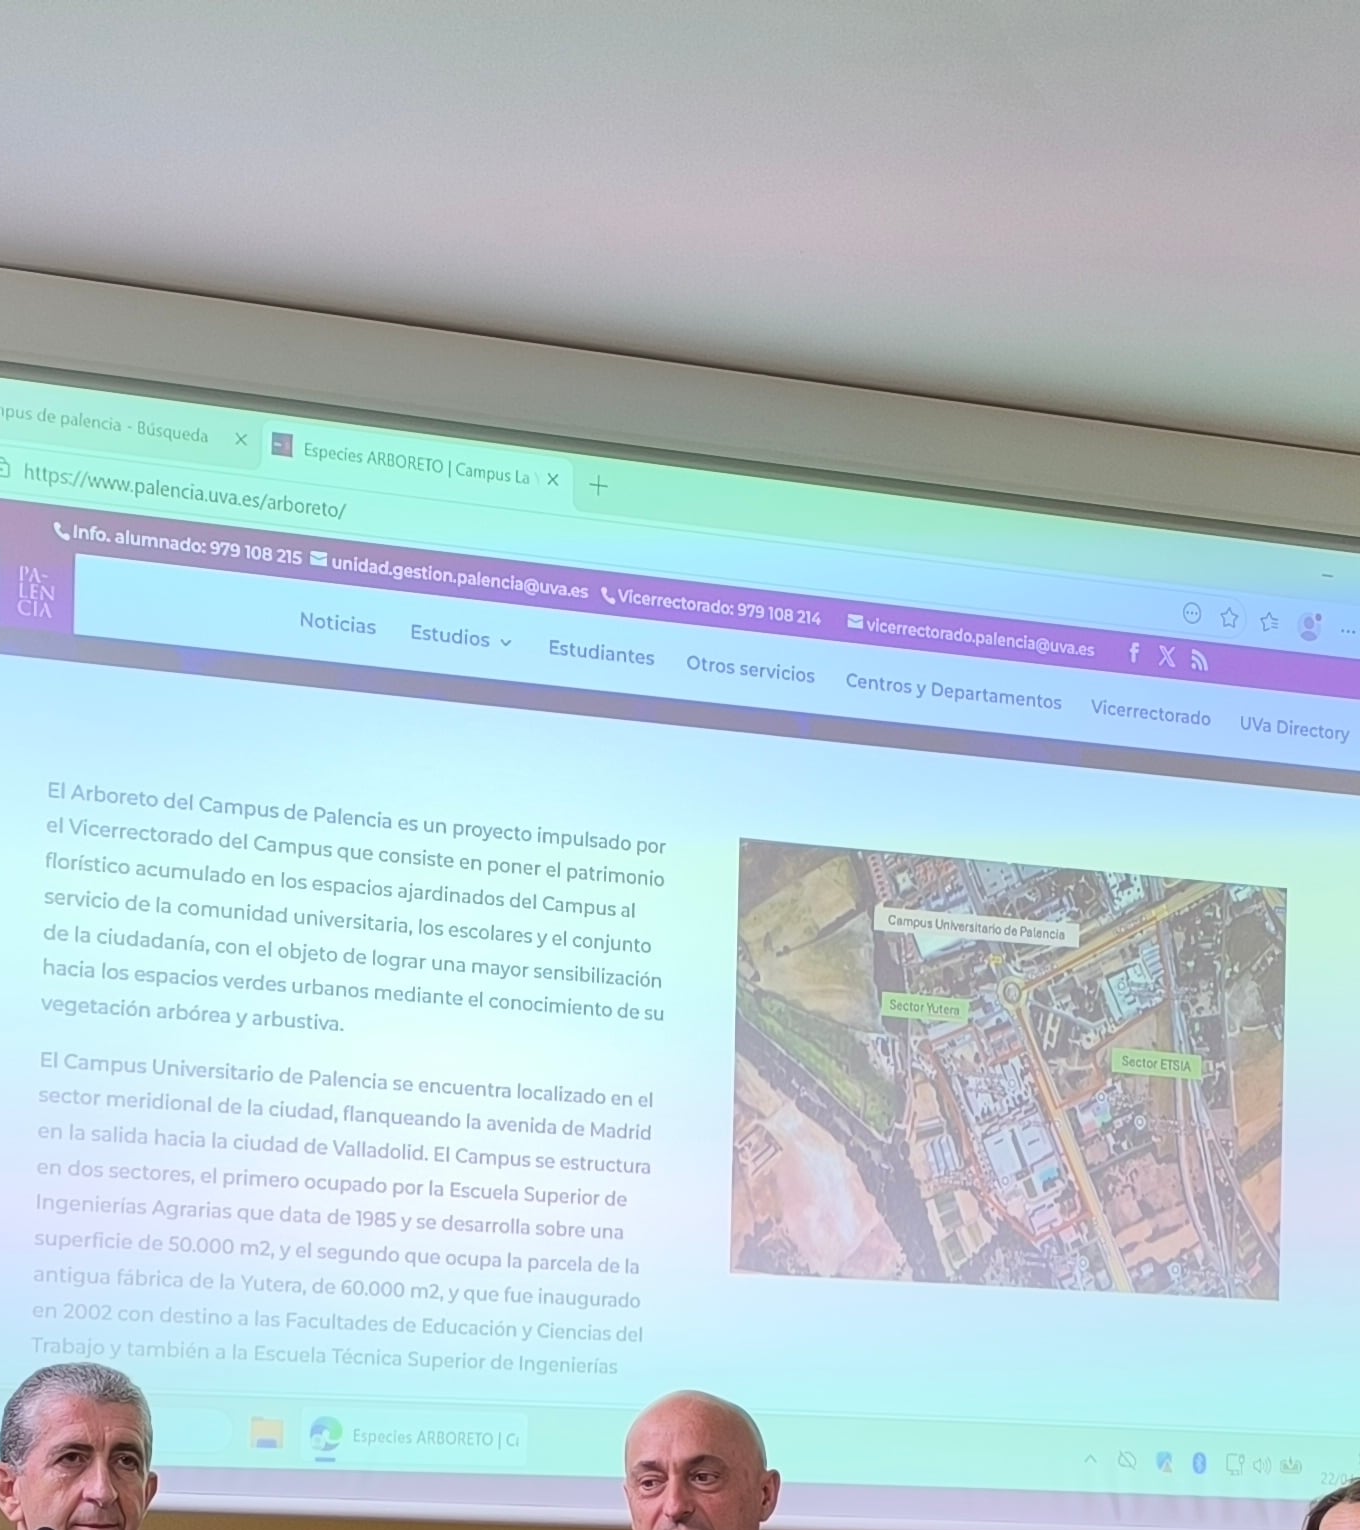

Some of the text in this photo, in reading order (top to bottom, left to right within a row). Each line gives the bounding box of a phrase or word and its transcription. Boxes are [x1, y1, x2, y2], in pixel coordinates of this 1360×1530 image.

[36, 406, 57, 425] de
[60, 411, 122, 433] palencia
[137, 419, 209, 444] Búsqueda
[304, 441, 363, 464] Especies
[366, 449, 444, 475] ARBORETO
[455, 460, 512, 485] Campus
[515, 469, 530, 486] La
[24, 462, 347, 522] https://www.palencia.uva.es/arboreto/
[72, 523, 303, 566] Info. alumnado: 979 108 215
[18, 582, 56, 601] LEN
[331, 555, 589, 600] unidad.gestion.palencia@uva.es
[16, 599, 53, 619] CIA
[300, 610, 377, 636] Noticias
[617, 587, 822, 626] Vicerrectorado: 979 108 214
[411, 622, 490, 649] Estudios
[549, 638, 655, 667] Estudiantes
[866, 616, 1095, 657] vicerrectorado.palencia@uva.es
[686, 654, 816, 685] Otros servicios
[845, 671, 1062, 711] Centros y Departamentos
[1090, 697, 1212, 727] Vicerrectorado
[1240, 715, 1351, 745] UVa Directory
[48, 781, 667, 857] El Arboreto del Campus de Palencia es un proyecto impulsado por
[46, 816, 665, 888] el Vicerrectorado del Campus que consiste en poner el patrimonio
[45, 850, 636, 919] florístico acumulado en los espacios ajardinados del Campus al
[44, 889, 652, 955] servicio de la comunidad universitaria, los escolares y el conjunto
[887, 913, 1066, 941] Campus Universitario de Palencia
[43, 922, 662, 990] de la ciudadanía, con el objeto de lograr una mayor sensibilización
[43, 957, 664, 1022] hacia los espacios verdes urbanos mediante el conocimiento de su
[889, 997, 960, 1017] Sector Yutera
[40, 996, 345, 1033] vegetación arbórea y arbustiva.
[40, 1050, 654, 1109] El Campus Universitario de Palencia se encuentra localizado en el
[1121, 1053, 1192, 1074] Sector ETSIA
[39, 1089, 652, 1142] sector meridional de la ciudad, flanqueando la avenida de Madrid
